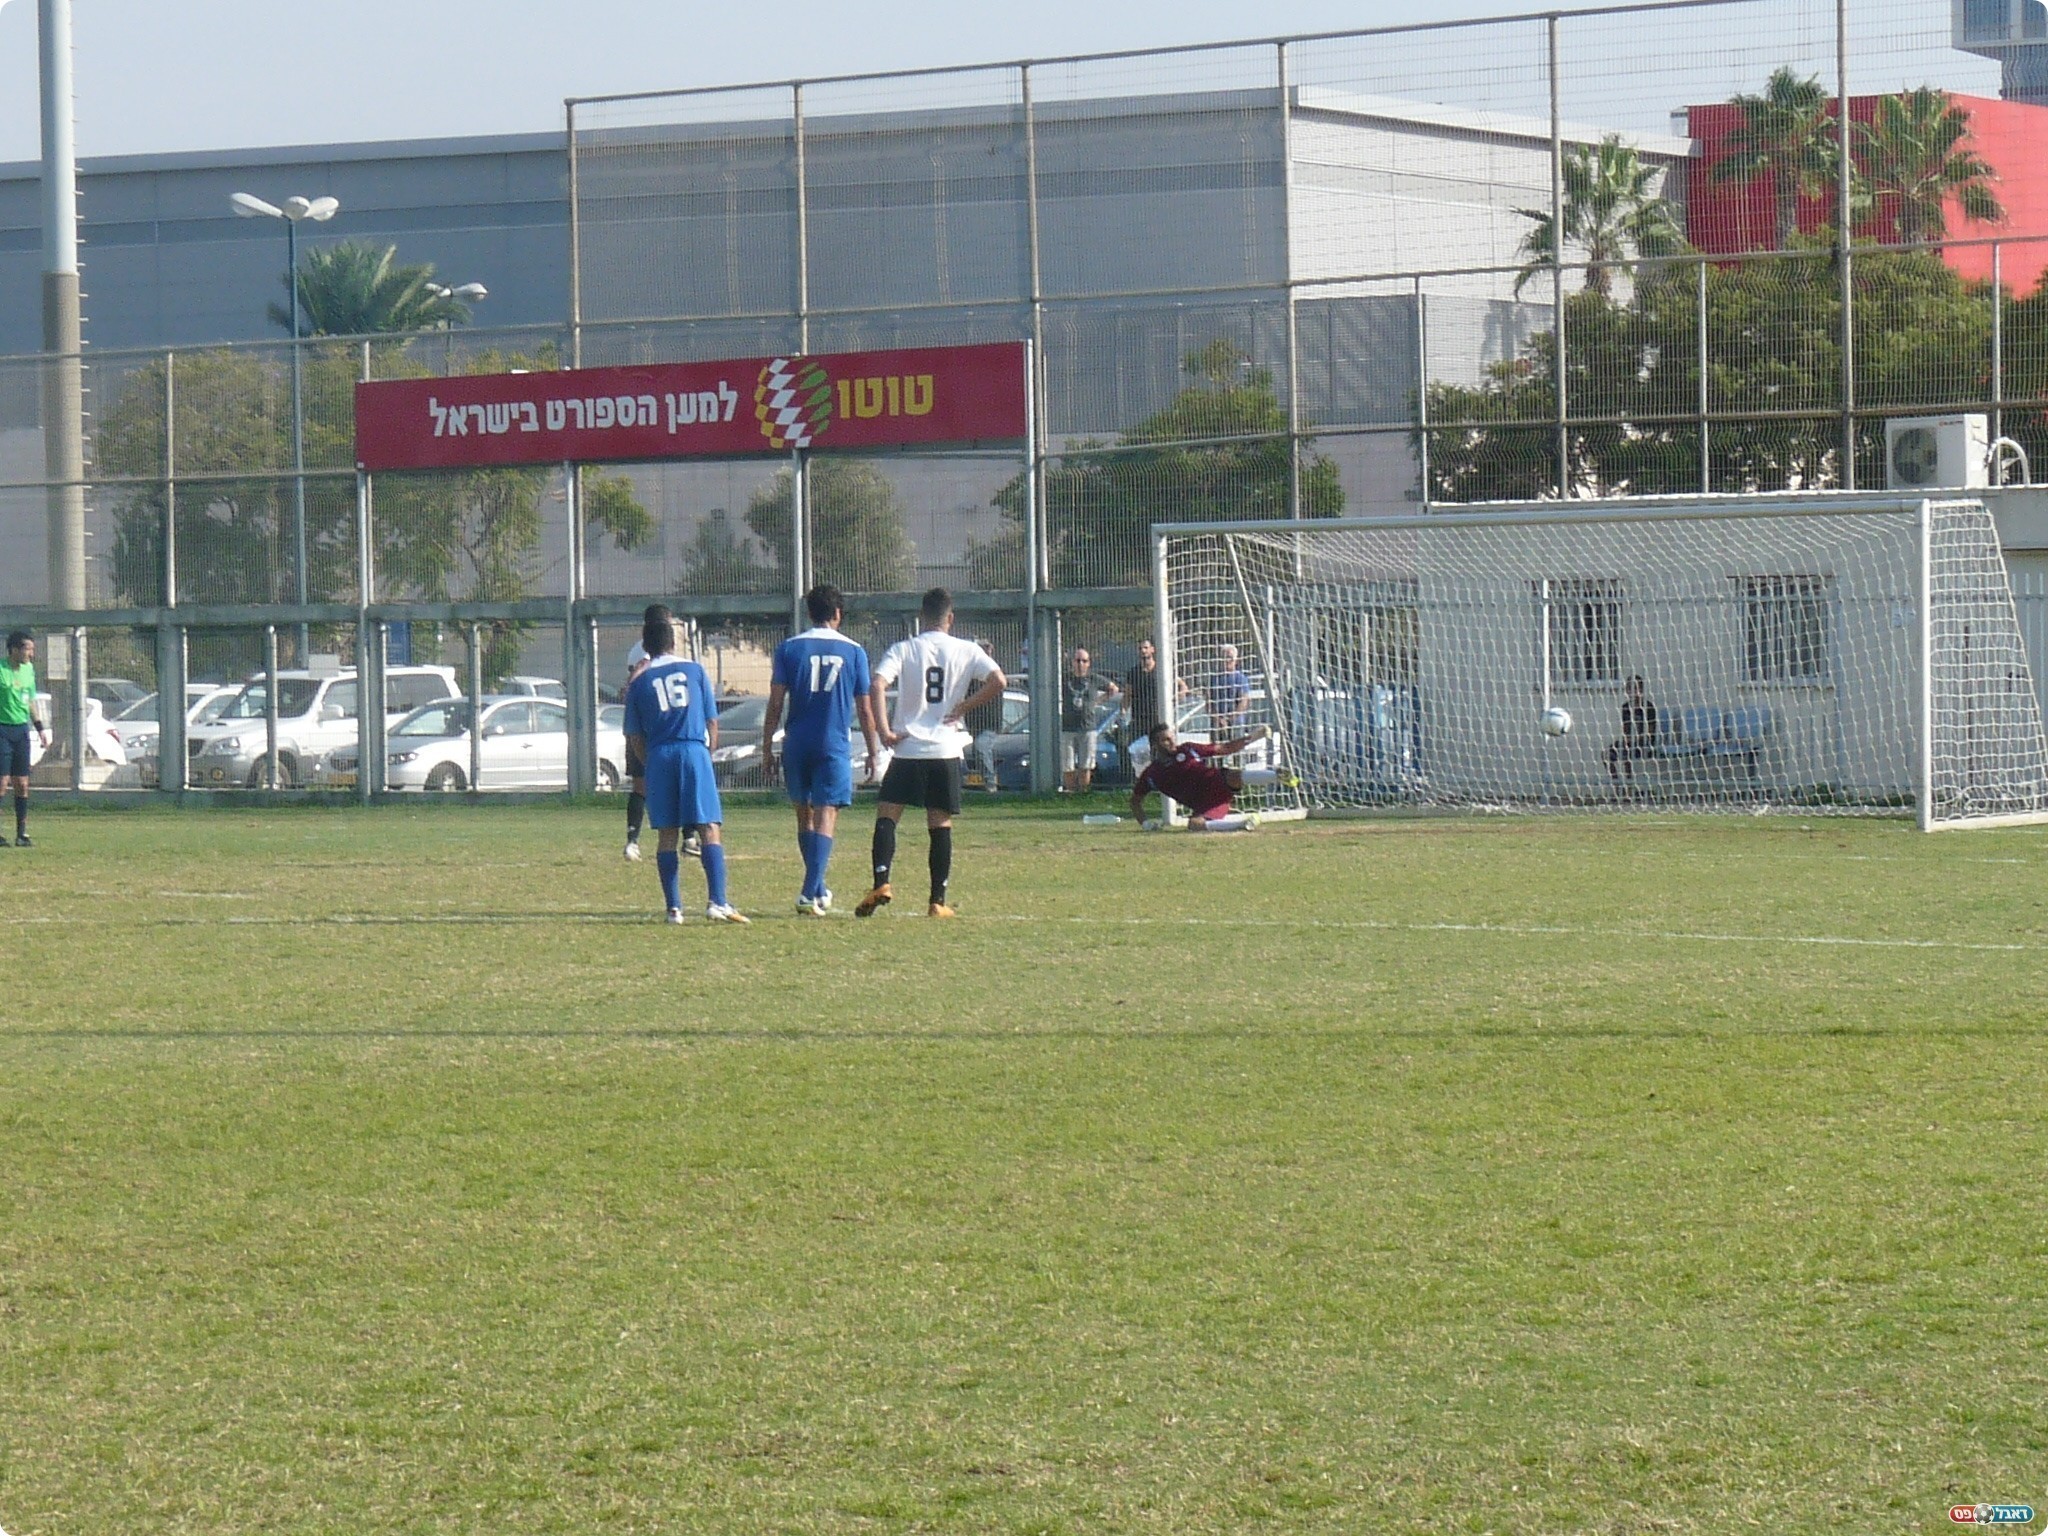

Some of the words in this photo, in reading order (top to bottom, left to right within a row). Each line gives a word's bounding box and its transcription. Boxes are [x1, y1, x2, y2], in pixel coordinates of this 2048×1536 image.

[546, 394, 656, 429] הספורט
[667, 382, 738, 434] למען
[837, 375, 934, 420] טוטו
[430, 398, 540, 437] בישראל
[652, 672, 689, 712] 16
[809, 655, 844, 693] 17
[925, 666, 945, 704] 8
